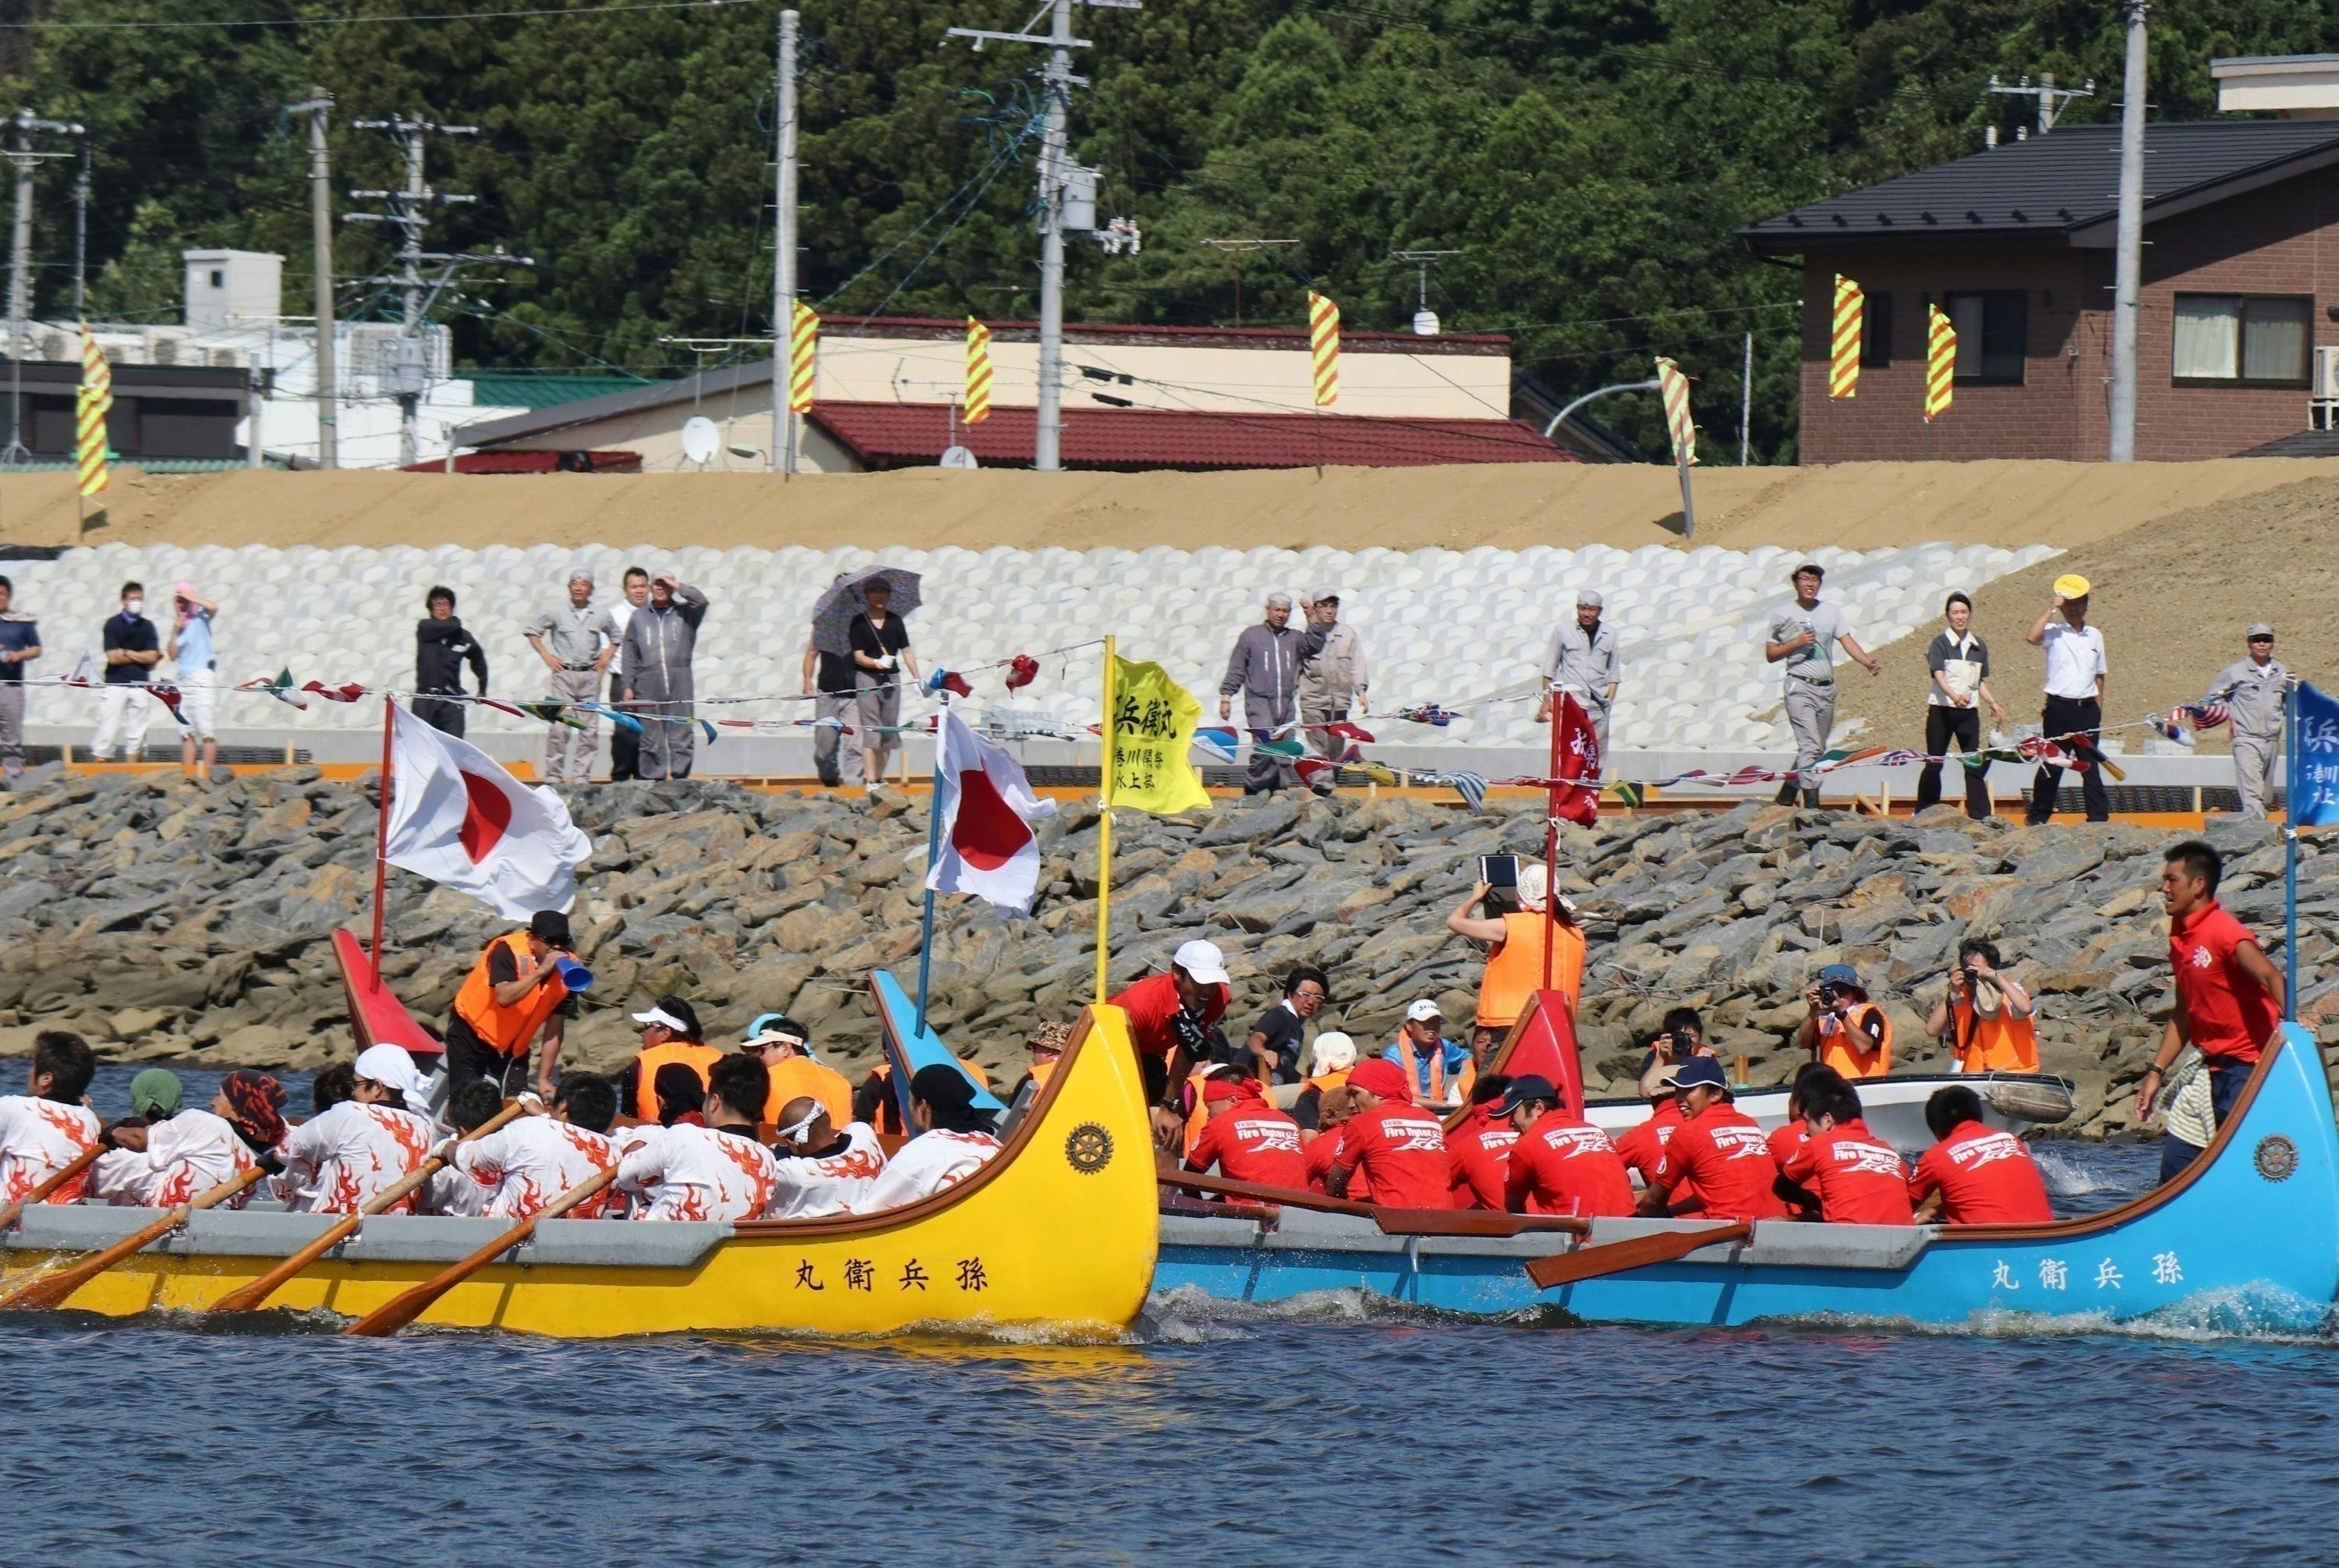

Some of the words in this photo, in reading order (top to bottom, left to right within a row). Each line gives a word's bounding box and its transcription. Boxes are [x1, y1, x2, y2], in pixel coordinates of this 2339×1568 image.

[1237, 1128, 1260, 1140] Fire
[1384, 1127, 1406, 1138] Fire
[1482, 1139, 1505, 1150] Fire
[1549, 1136, 1571, 1149] Fire
[1715, 1136, 1737, 1149] Fire
[1834, 1150, 1856, 1161] Fire
[1952, 1149, 1976, 1164] Fire
